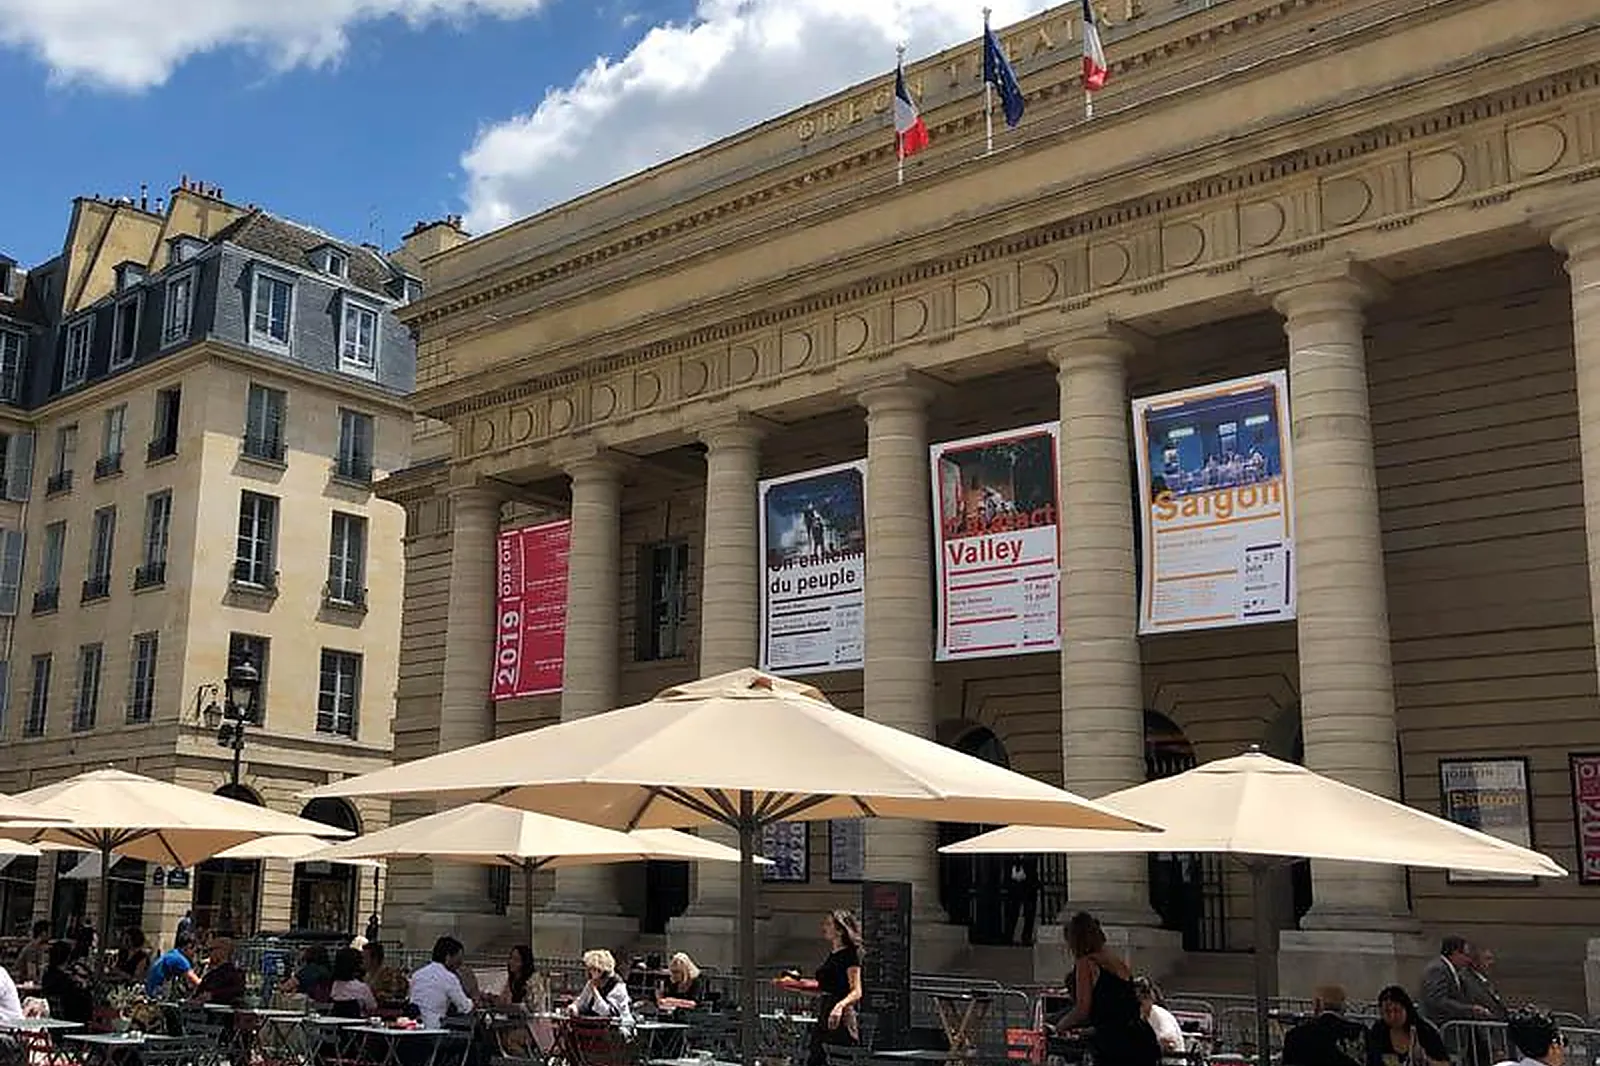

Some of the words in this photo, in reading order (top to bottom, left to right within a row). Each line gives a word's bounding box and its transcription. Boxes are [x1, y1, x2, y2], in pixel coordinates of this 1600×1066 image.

[1154, 480, 1280, 520] Saigon
[949, 538, 1023, 566] Valley
[771, 577, 791, 594] du
[797, 567, 856, 594] peuple
[497, 611, 519, 686] 2019
